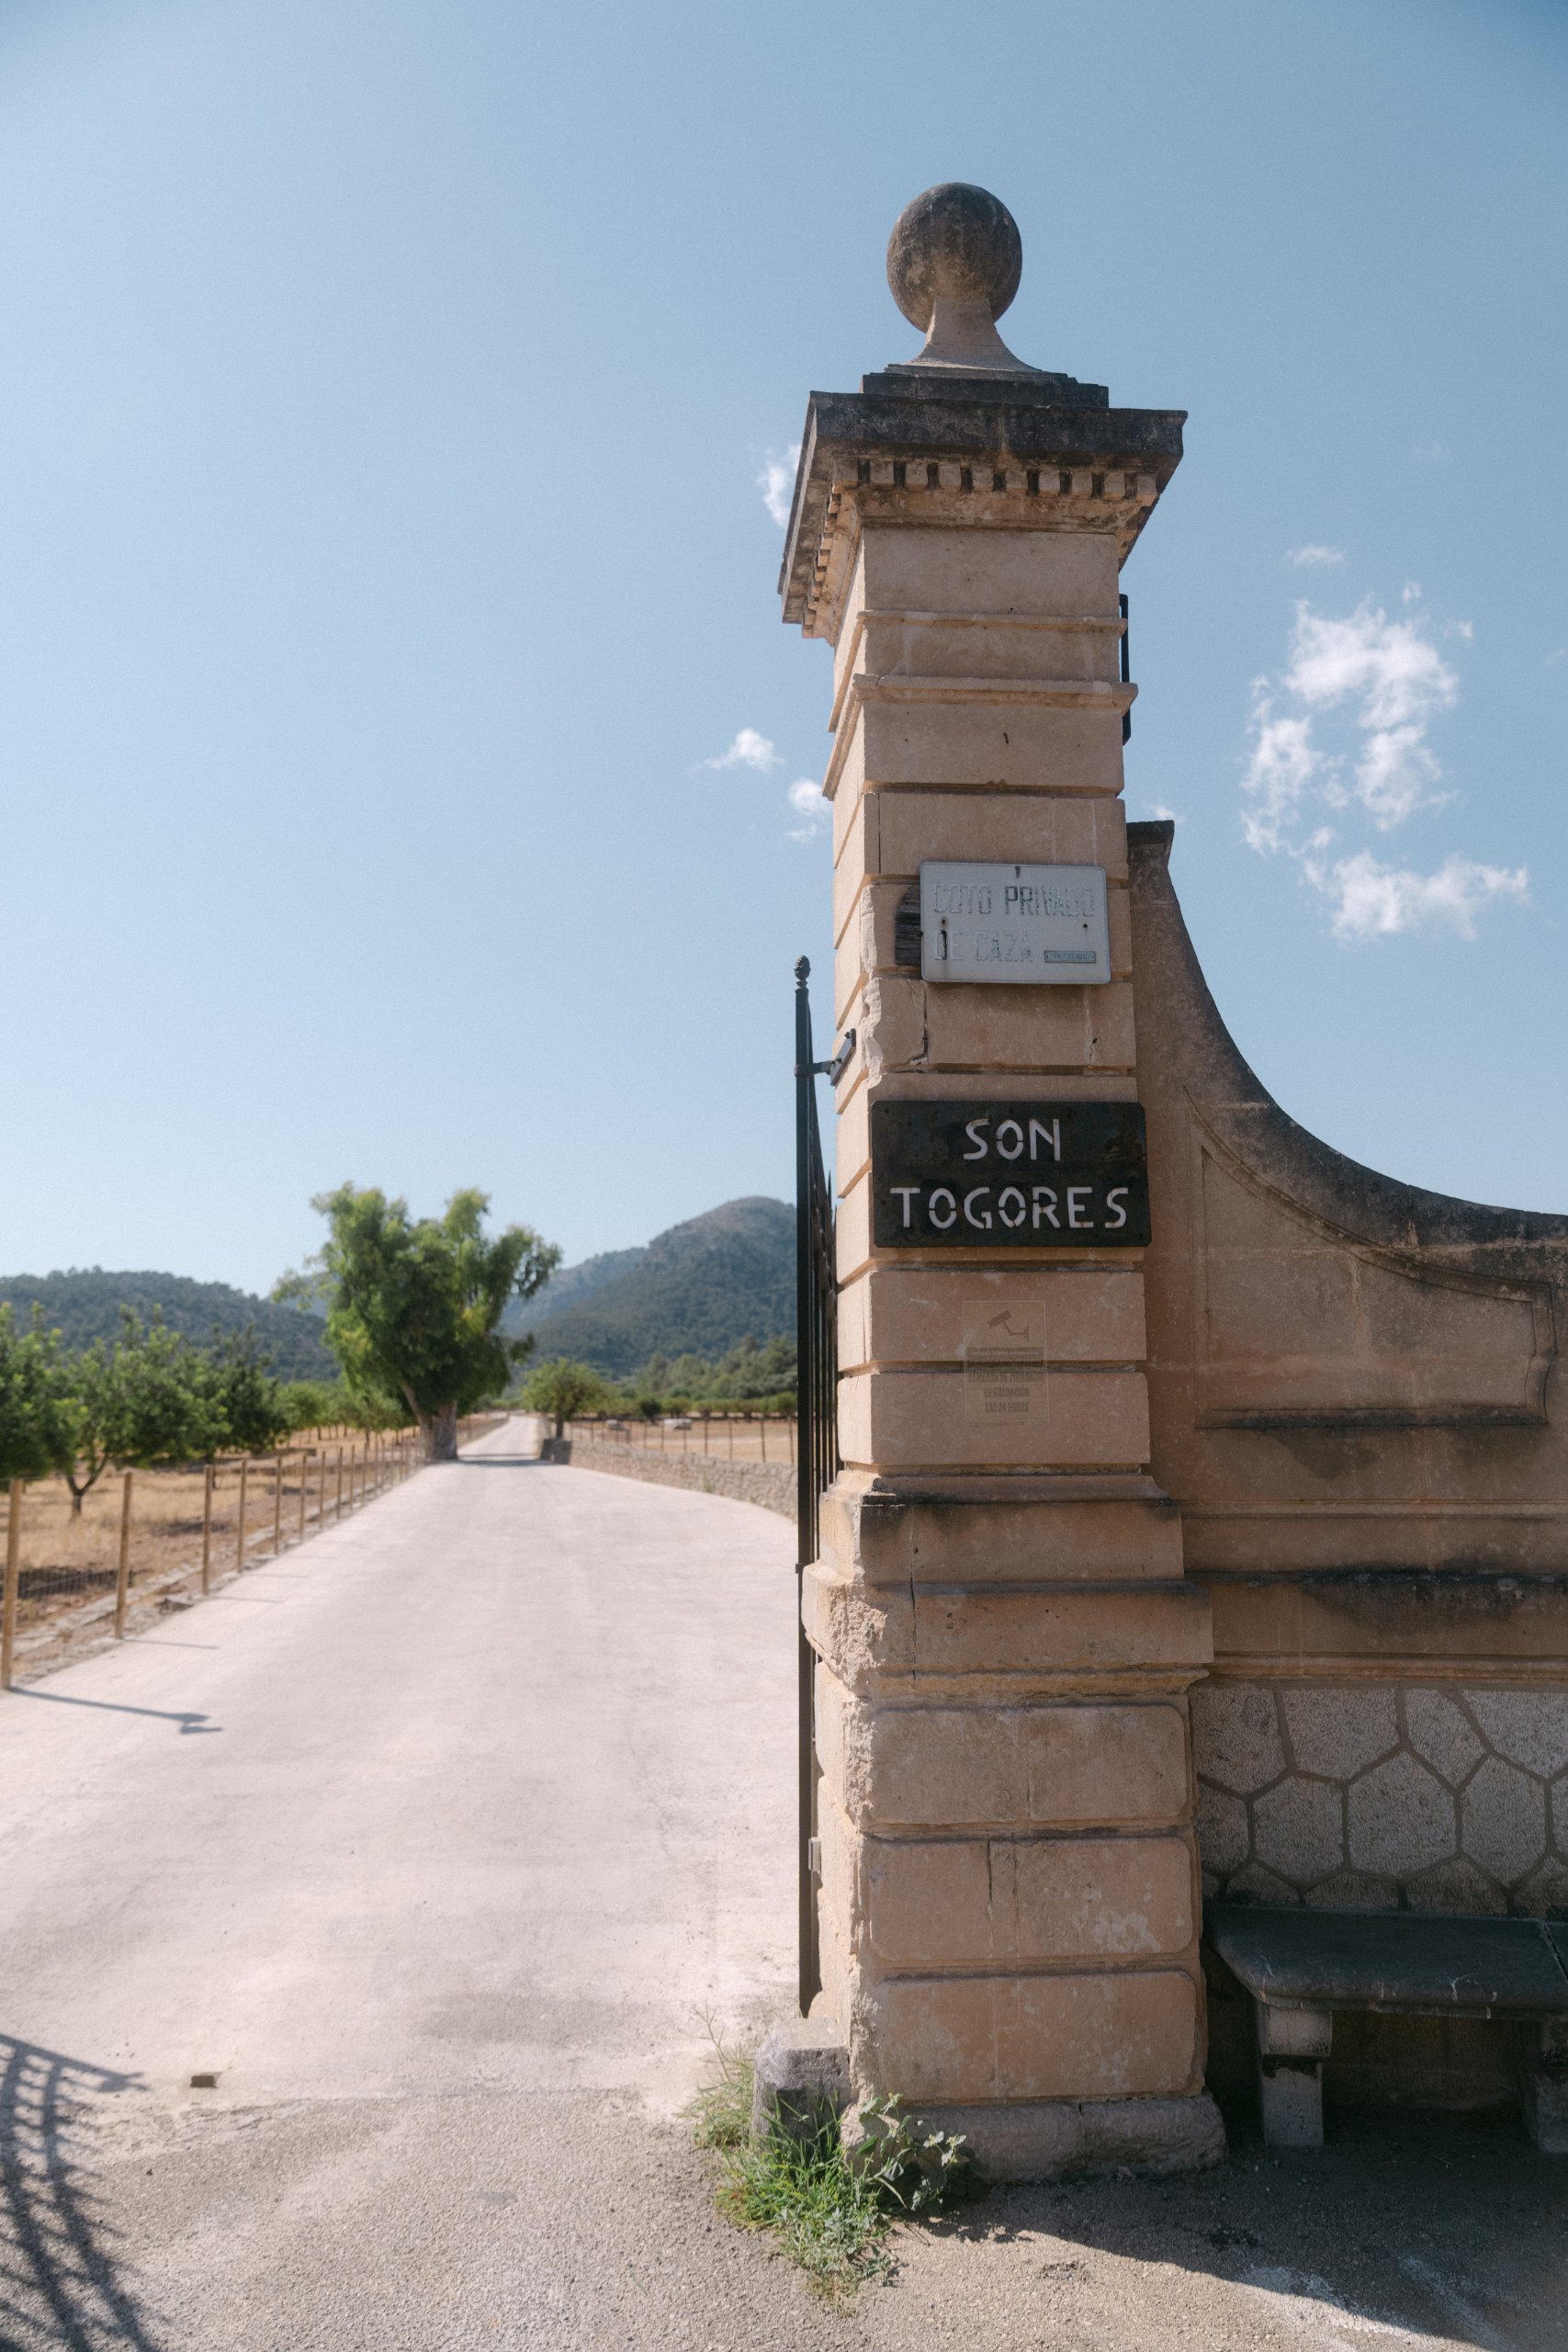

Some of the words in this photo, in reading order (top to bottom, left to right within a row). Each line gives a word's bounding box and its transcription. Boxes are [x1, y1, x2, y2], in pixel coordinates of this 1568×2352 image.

[934, 930, 964, 960] DE
[964, 1118, 1060, 1161] SON
[890, 1186, 1128, 1229] TOGORES
